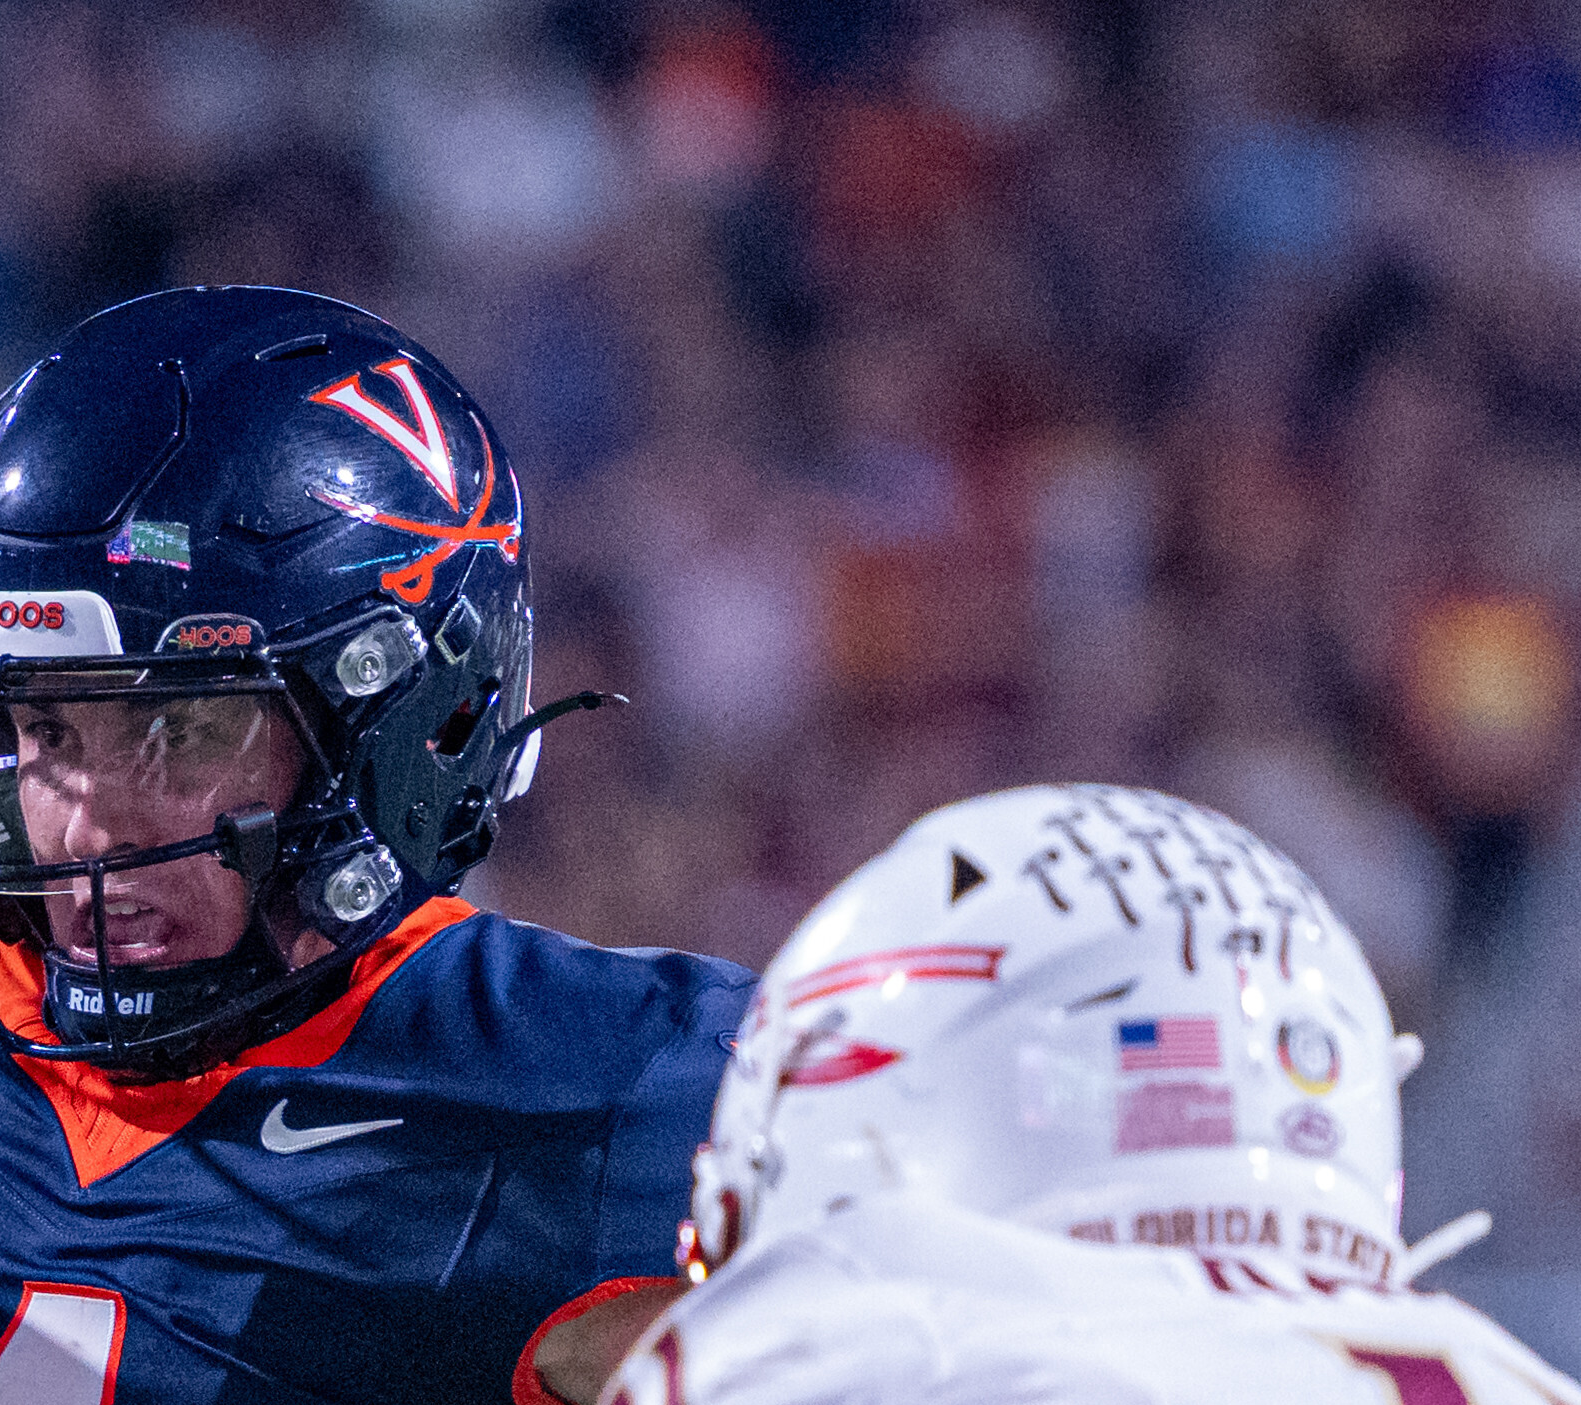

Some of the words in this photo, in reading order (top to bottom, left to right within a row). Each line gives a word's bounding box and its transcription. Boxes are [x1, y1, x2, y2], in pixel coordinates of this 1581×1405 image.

[308, 357, 460, 514] V
[179, 624, 253, 649] HOOS
[67, 986, 155, 1015] Ridell
